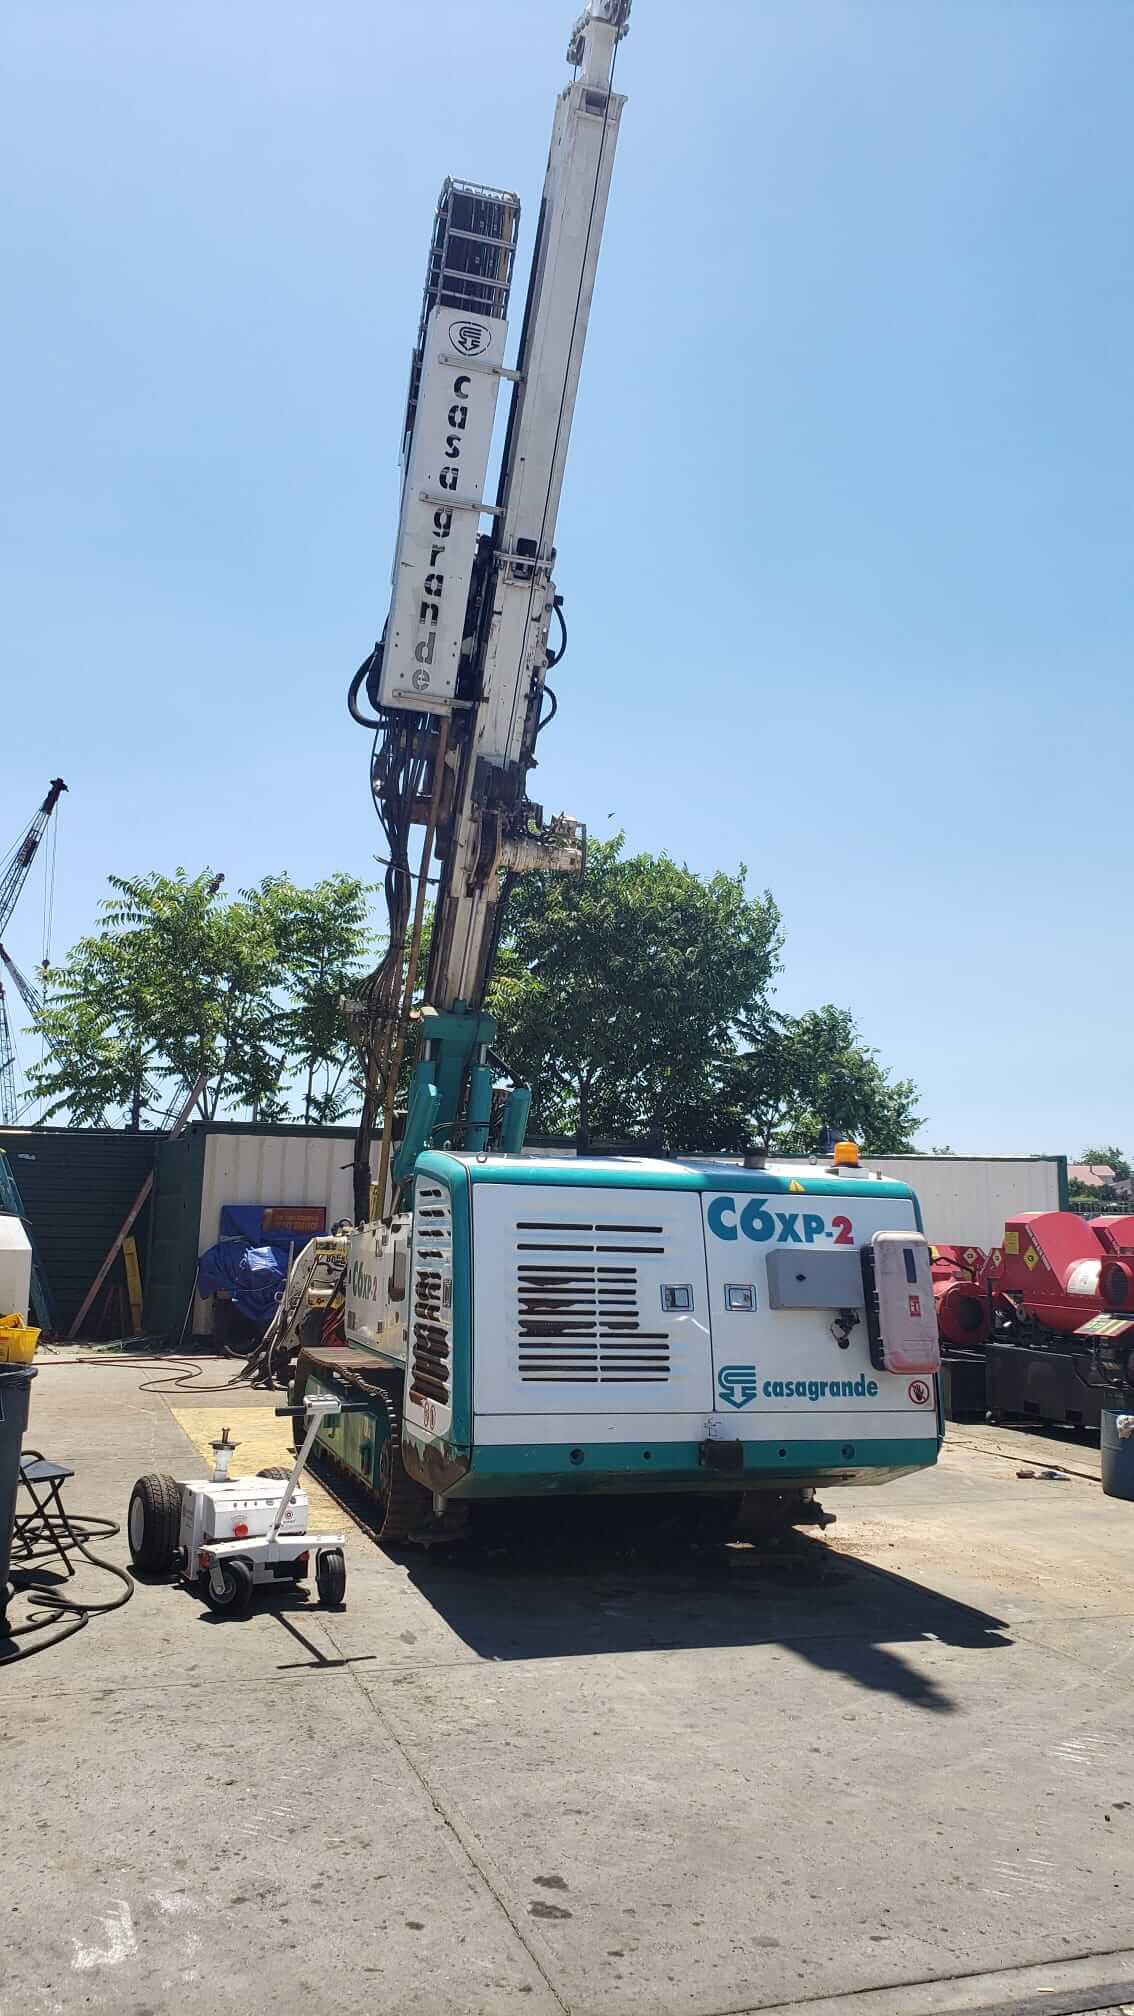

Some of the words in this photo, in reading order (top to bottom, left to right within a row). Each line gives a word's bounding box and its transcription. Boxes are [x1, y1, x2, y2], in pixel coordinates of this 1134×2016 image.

[411, 375, 472, 690] casagrande
[707, 1196, 855, 1245] C6XP-2
[762, 1373, 879, 1401] casagrande
